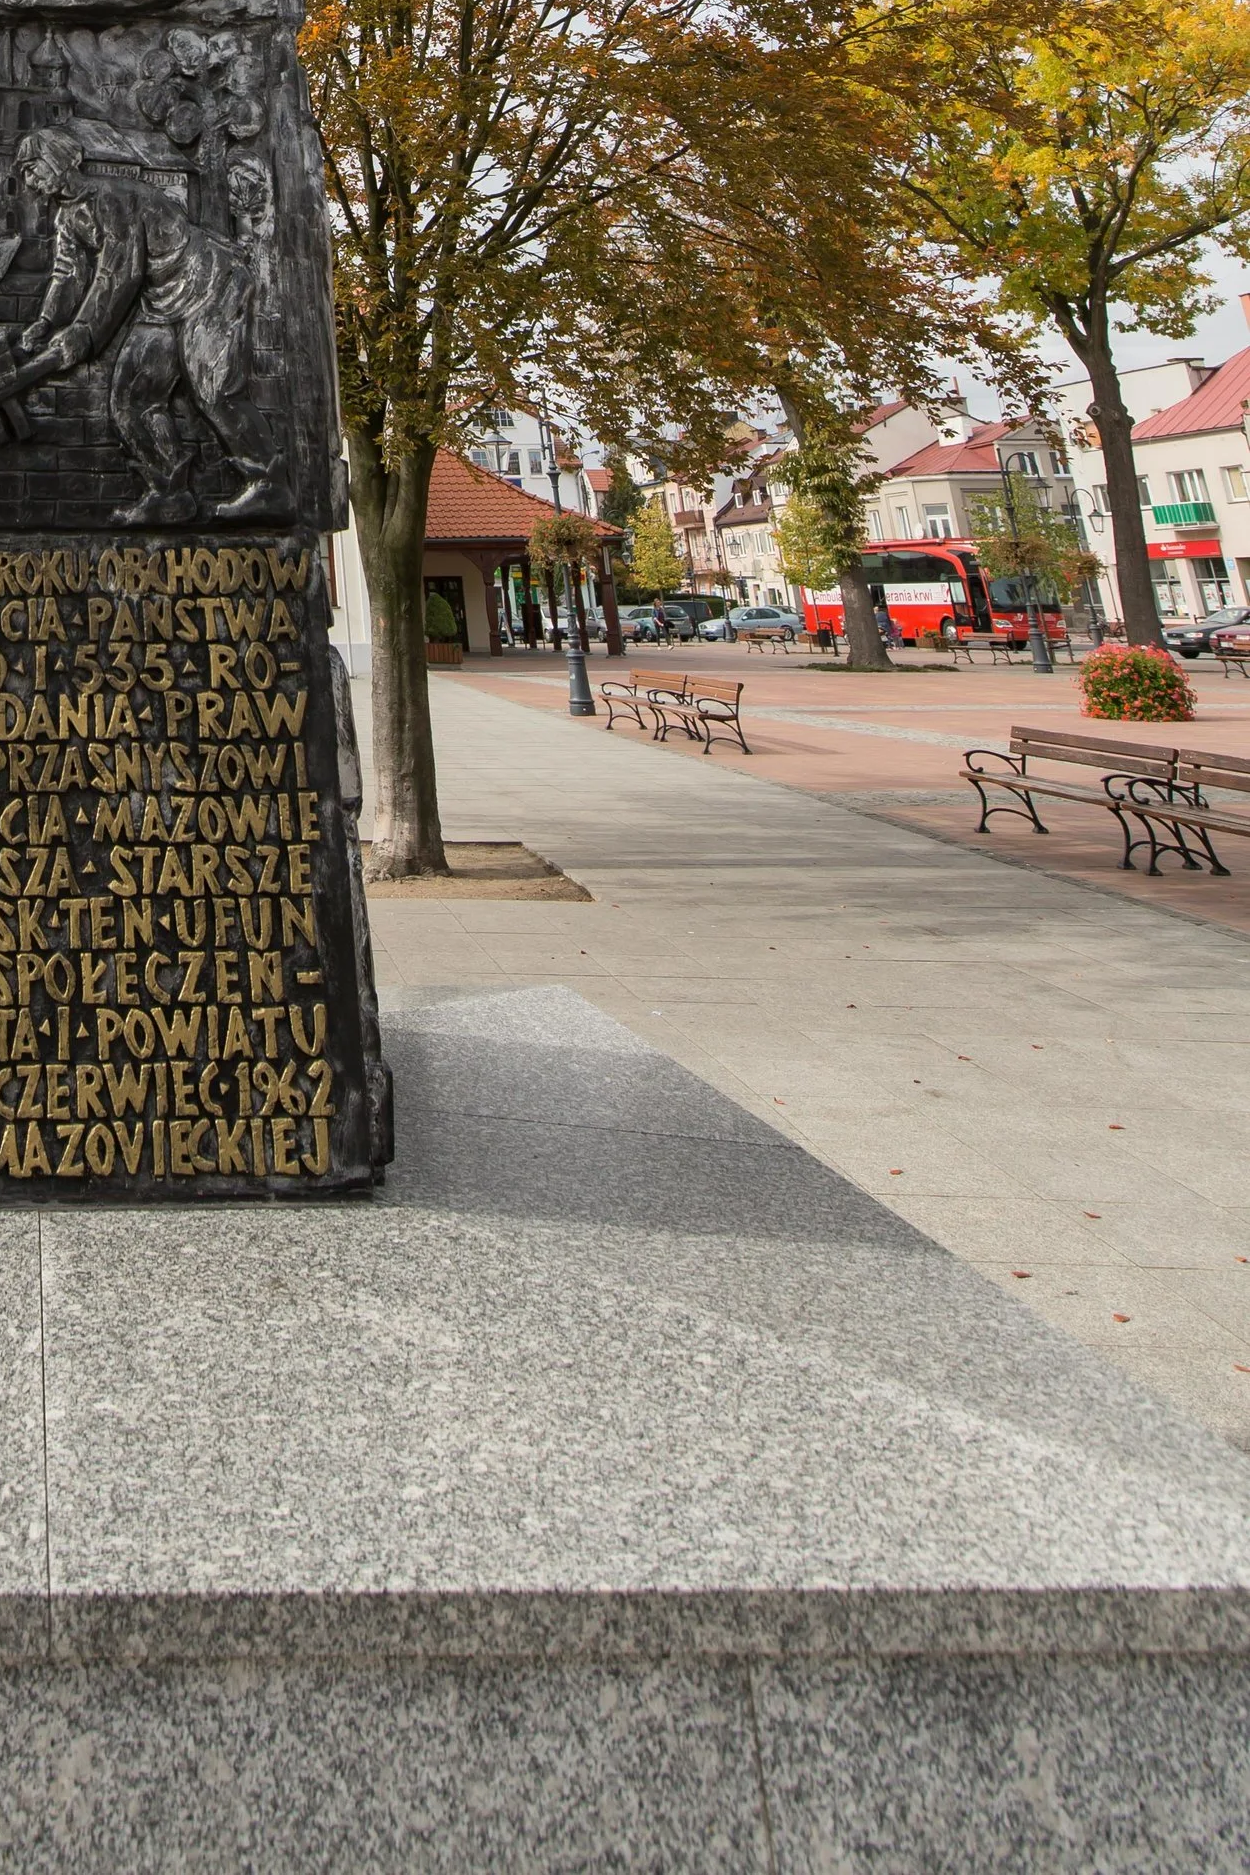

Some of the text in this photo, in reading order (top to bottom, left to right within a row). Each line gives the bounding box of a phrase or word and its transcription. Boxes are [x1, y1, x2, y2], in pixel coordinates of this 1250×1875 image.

[815, 589, 934, 602] Ambula erania krwi
[70, 641, 175, 695] 535
[163, 689, 309, 740] PRAW
[91, 791, 321, 843] MAZOWIE
[107, 843, 313, 897] STARSZE
[58, 895, 154, 950] TEN
[172, 896, 317, 951] UFUN
[95, 1003, 328, 1062] POWIATU
[233, 1057, 337, 1118] 1962
